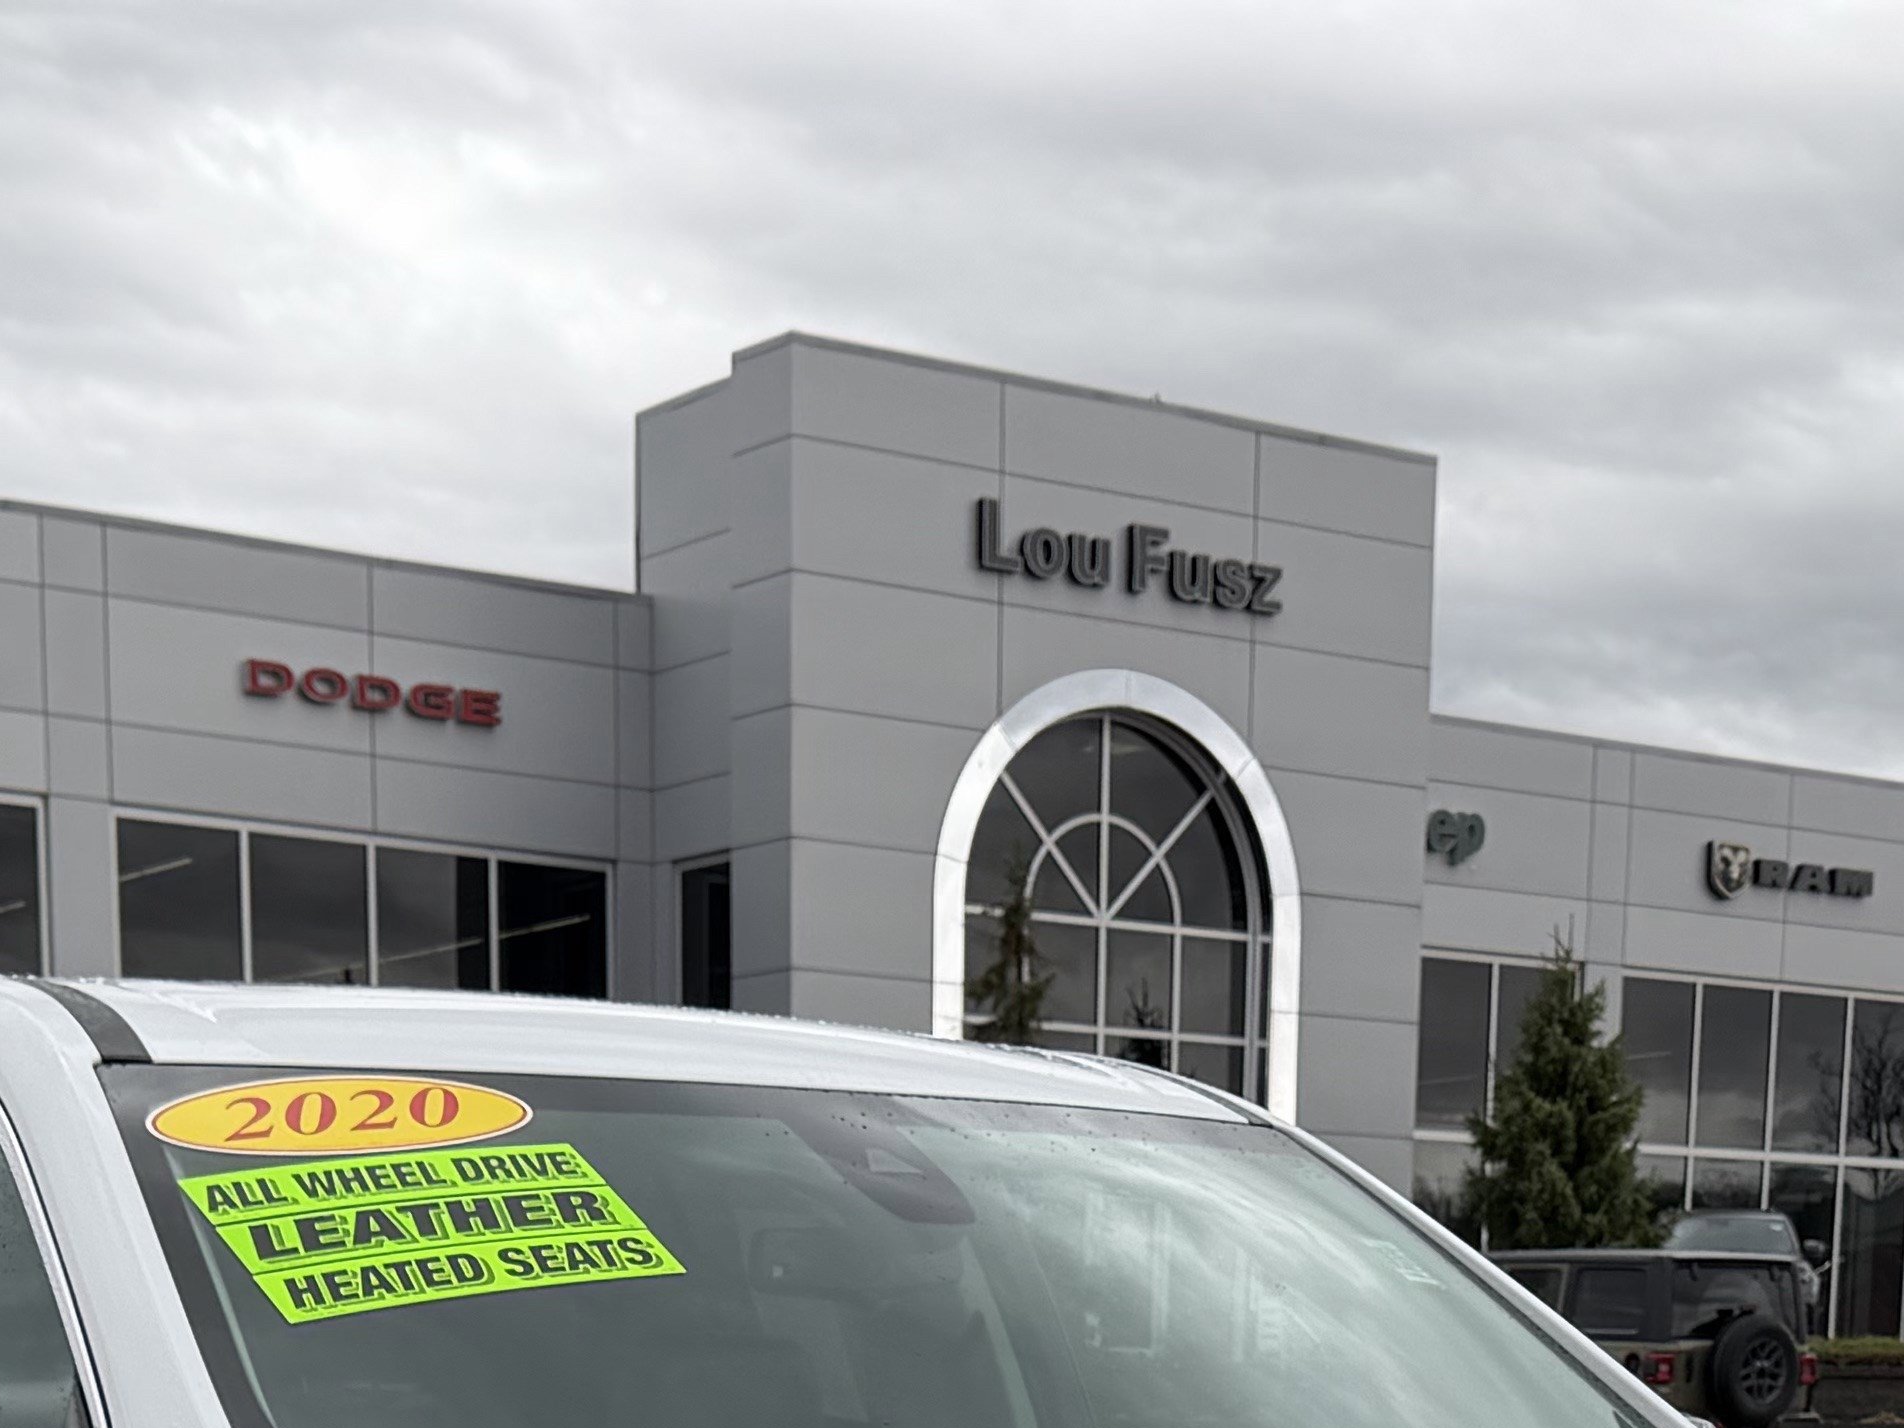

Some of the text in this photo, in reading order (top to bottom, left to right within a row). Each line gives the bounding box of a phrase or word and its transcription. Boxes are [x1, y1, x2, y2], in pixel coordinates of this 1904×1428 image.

[974, 497, 1284, 617] Lou Fusz
[244, 658, 502, 728] DODGE
[1752, 858, 1874, 899] RAM
[224, 1086, 460, 1143] 2020
[206, 1151, 584, 1214] ALL WHEEL DRIVE
[249, 1190, 618, 1263] LEATHER
[283, 1236, 659, 1311] HEATED SEATS
